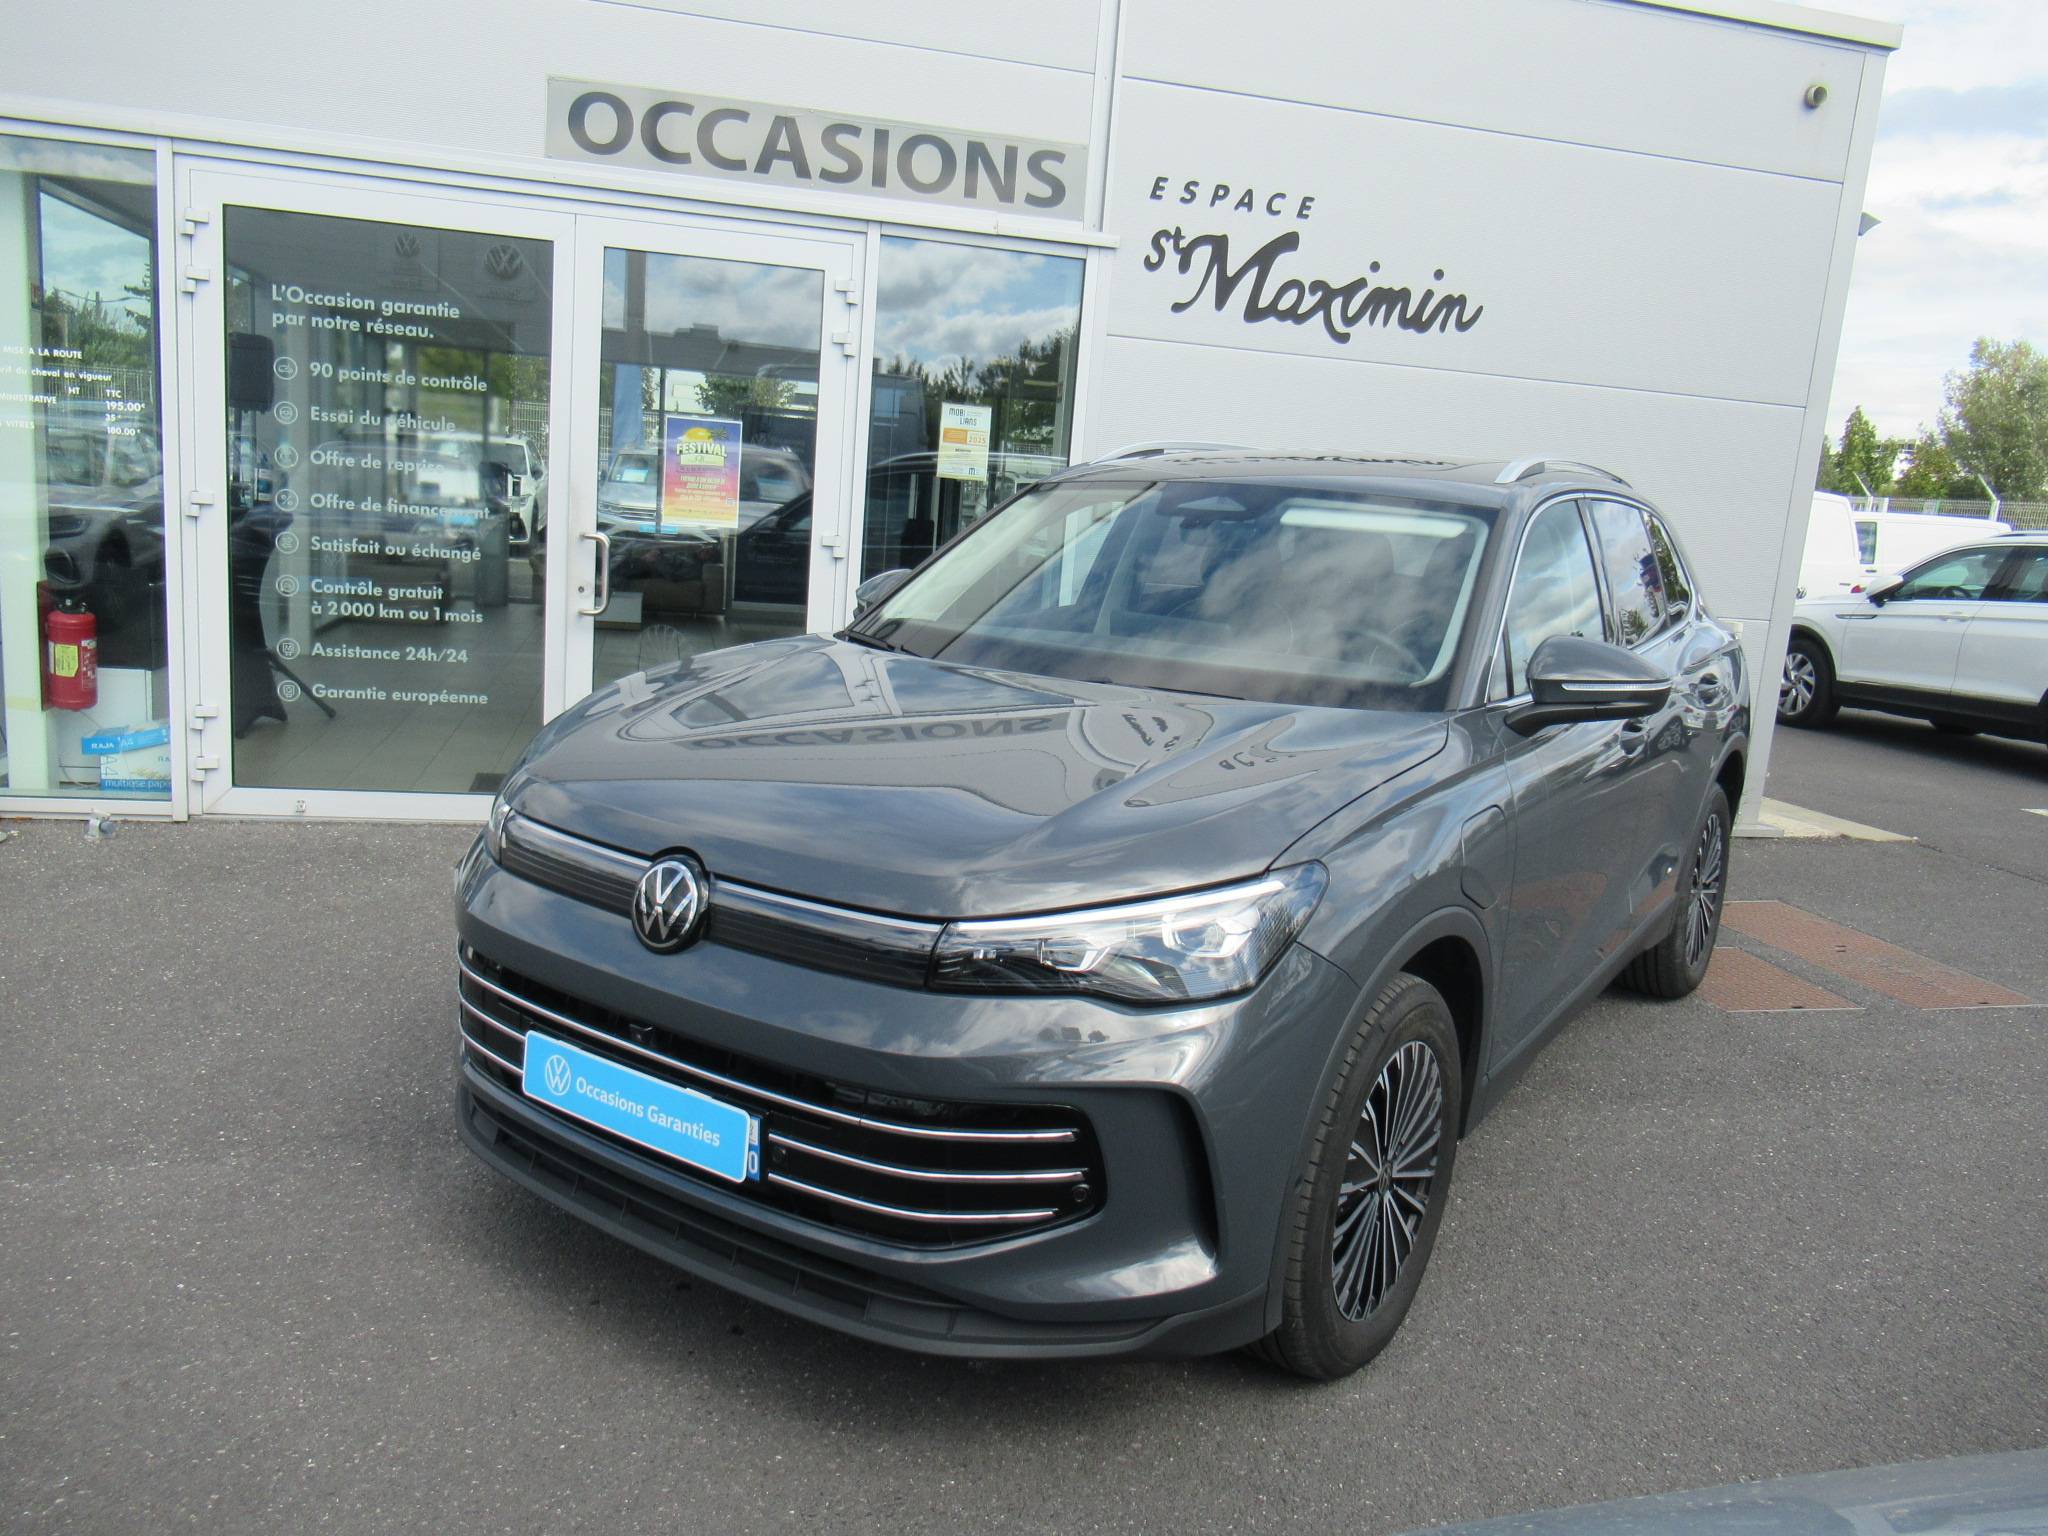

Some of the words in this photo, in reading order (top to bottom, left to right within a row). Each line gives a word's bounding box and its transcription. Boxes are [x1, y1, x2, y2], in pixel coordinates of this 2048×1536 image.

[567, 91, 1067, 209] OCCASIONS
[1149, 176, 1315, 220] ESPACE
[1171, 231, 1484, 344] Maximin
[272, 284, 375, 311] L'Occasion
[381, 301, 461, 319] garantie
[272, 312, 306, 327] par
[311, 316, 361, 331] notre
[366, 318, 435, 338] réseau.
[38, 348, 50, 357] LA
[53, 349, 82, 359] ROUTE
[310, 361, 333, 378] 90
[338, 366, 392, 383] points
[395, 369, 416, 385] de
[421, 375, 488, 392] contrôle
[105, 390, 122, 399] TTC
[310, 406, 354, 424] Essai
[359, 410, 381, 426] du
[310, 450, 356, 468] Offre
[360, 453, 382, 469] de
[676, 442, 728, 457] FESTIVAL
[310, 493, 355, 510] Offre
[360, 497, 382, 512] de
[311, 535, 380, 554] Satisfait
[385, 545, 406, 556] ou
[411, 543, 482, 563] échangé
[311, 578, 383, 597] Contrôle
[388, 585, 444, 601] gratuit
[311, 601, 322, 615] à
[379, 604, 405, 619] km
[408, 609, 429, 621] ou
[433, 606, 442, 621] 1
[445, 610, 484, 624] mois
[311, 642, 400, 660] Assistance
[405, 646, 469, 664] 24h/24
[312, 683, 387, 700] Garantie
[392, 689, 488, 706] européenne
[91, 742, 115, 750] RAJA
[576, 1076, 645, 1118] Occasions
[647, 1104, 721, 1147] Garanties
